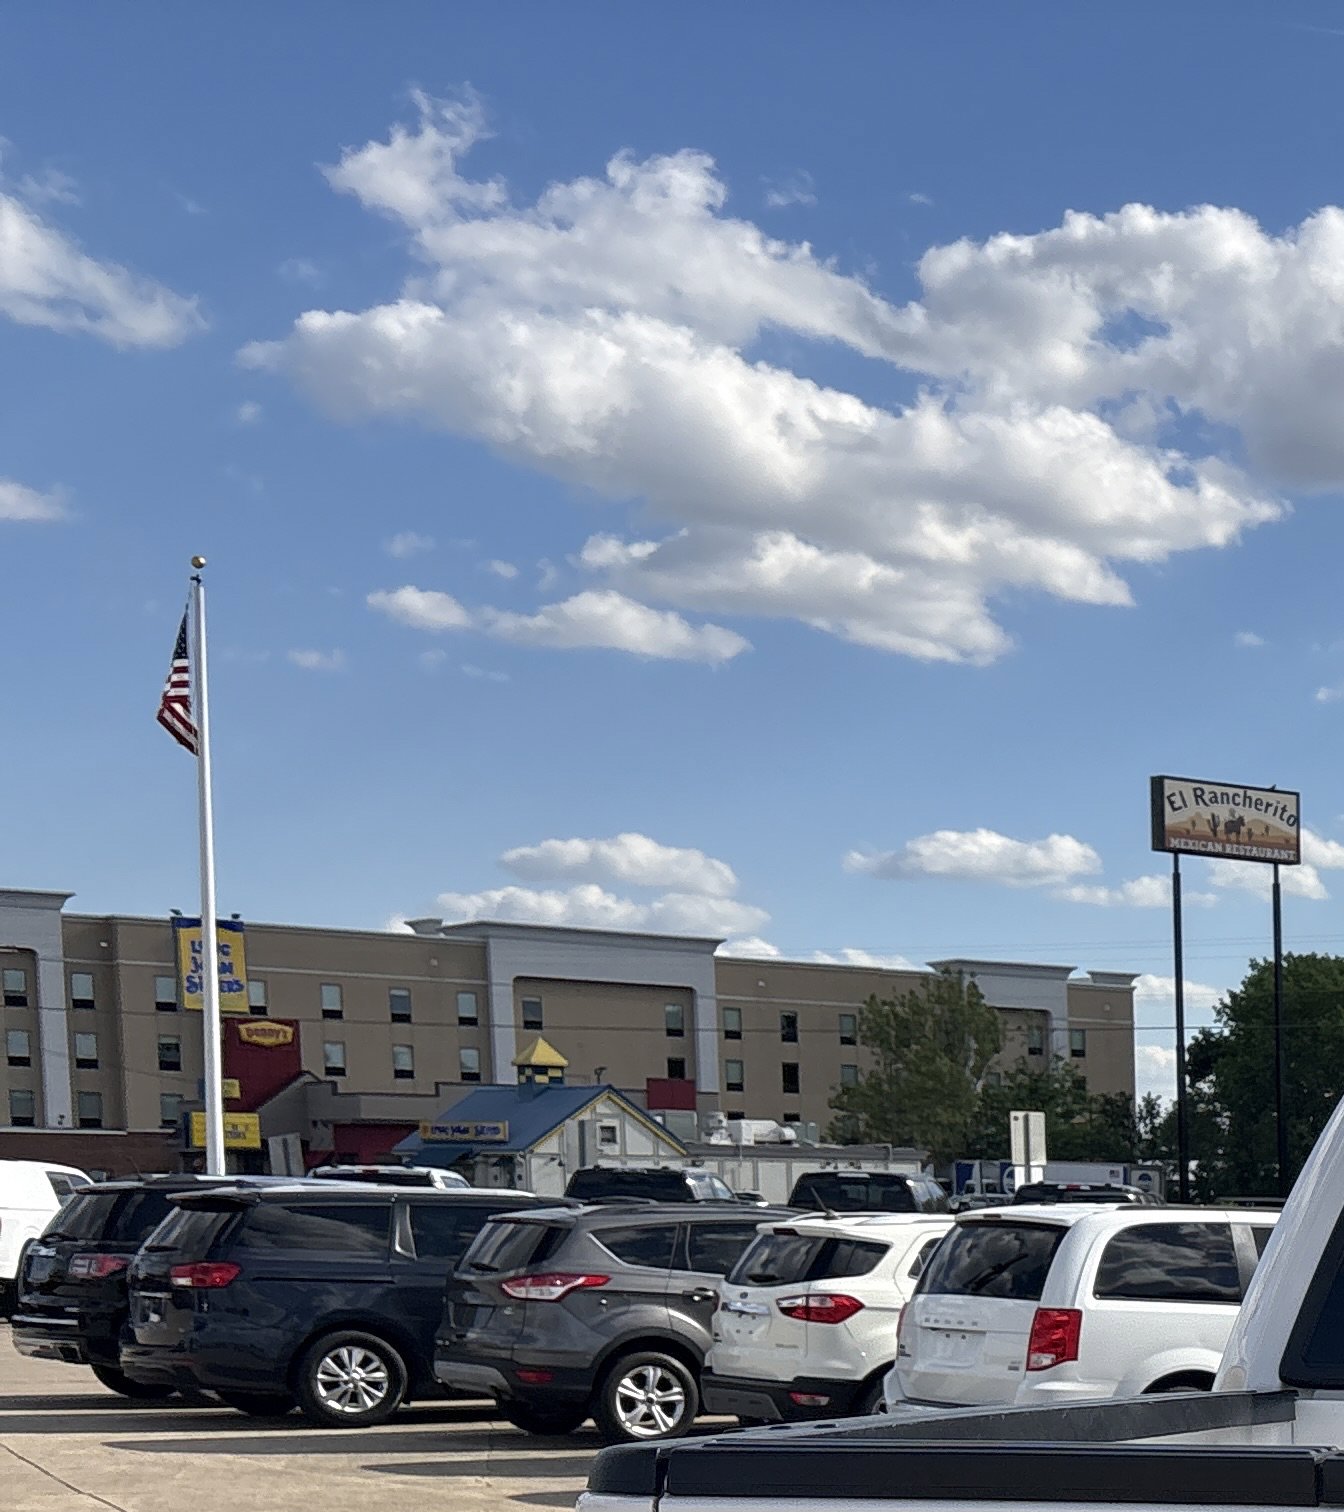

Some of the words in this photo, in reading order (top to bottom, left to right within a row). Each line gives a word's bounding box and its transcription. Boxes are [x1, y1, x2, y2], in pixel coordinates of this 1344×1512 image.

[1167, 790, 1188, 812] El
[1192, 786, 1298, 828] Rancherito
[1169, 837, 1223, 853] MEXICAN
[1225, 843, 1296, 861] RESTAURANT
